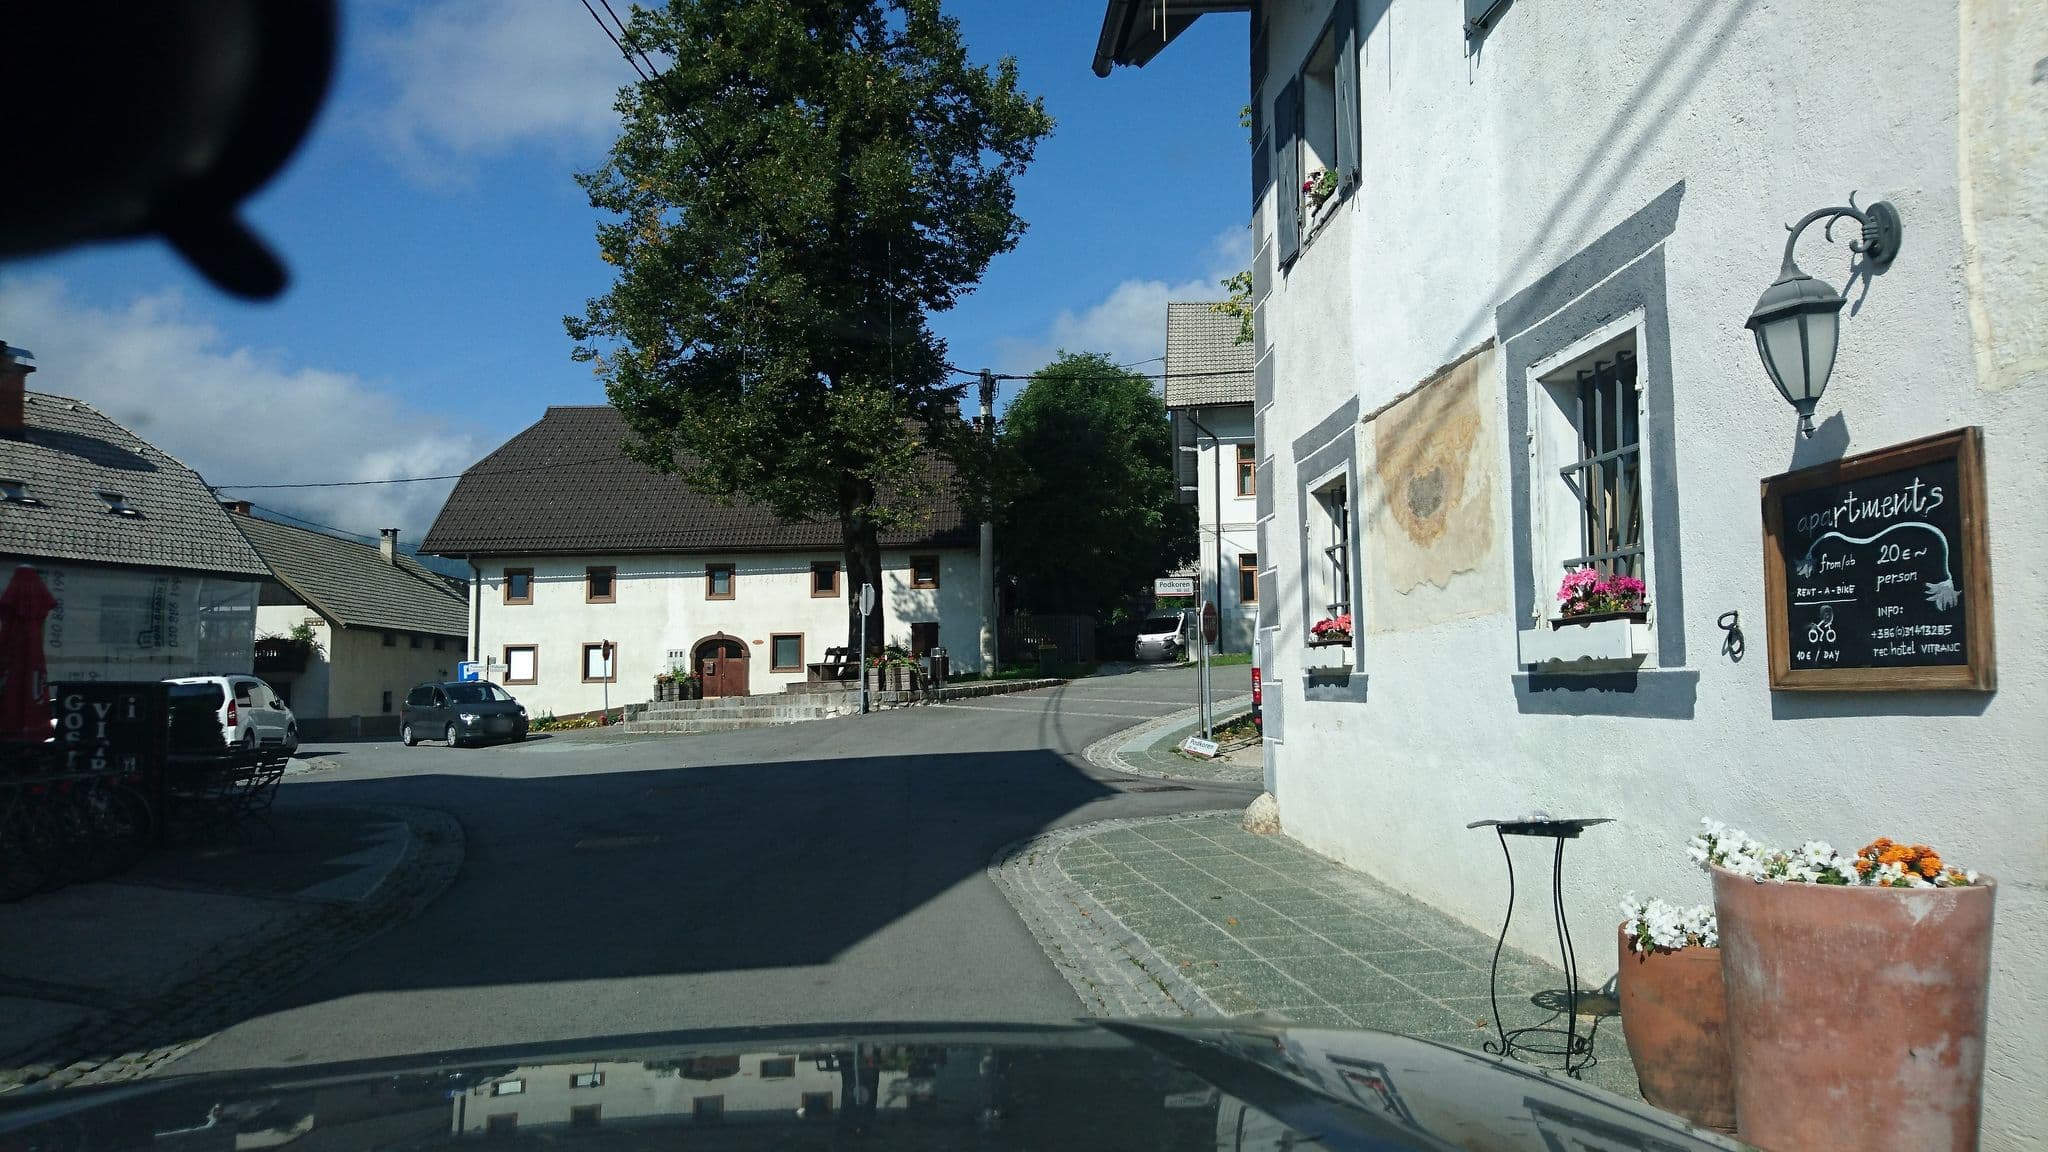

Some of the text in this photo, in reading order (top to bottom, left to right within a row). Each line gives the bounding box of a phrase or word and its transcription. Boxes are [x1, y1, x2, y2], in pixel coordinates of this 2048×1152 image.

[1797, 477, 1944, 537] apartments
[1875, 571, 1918, 592] person
[1877, 606, 1904, 618] INFO:
[1823, 650, 1841, 662] DAY
